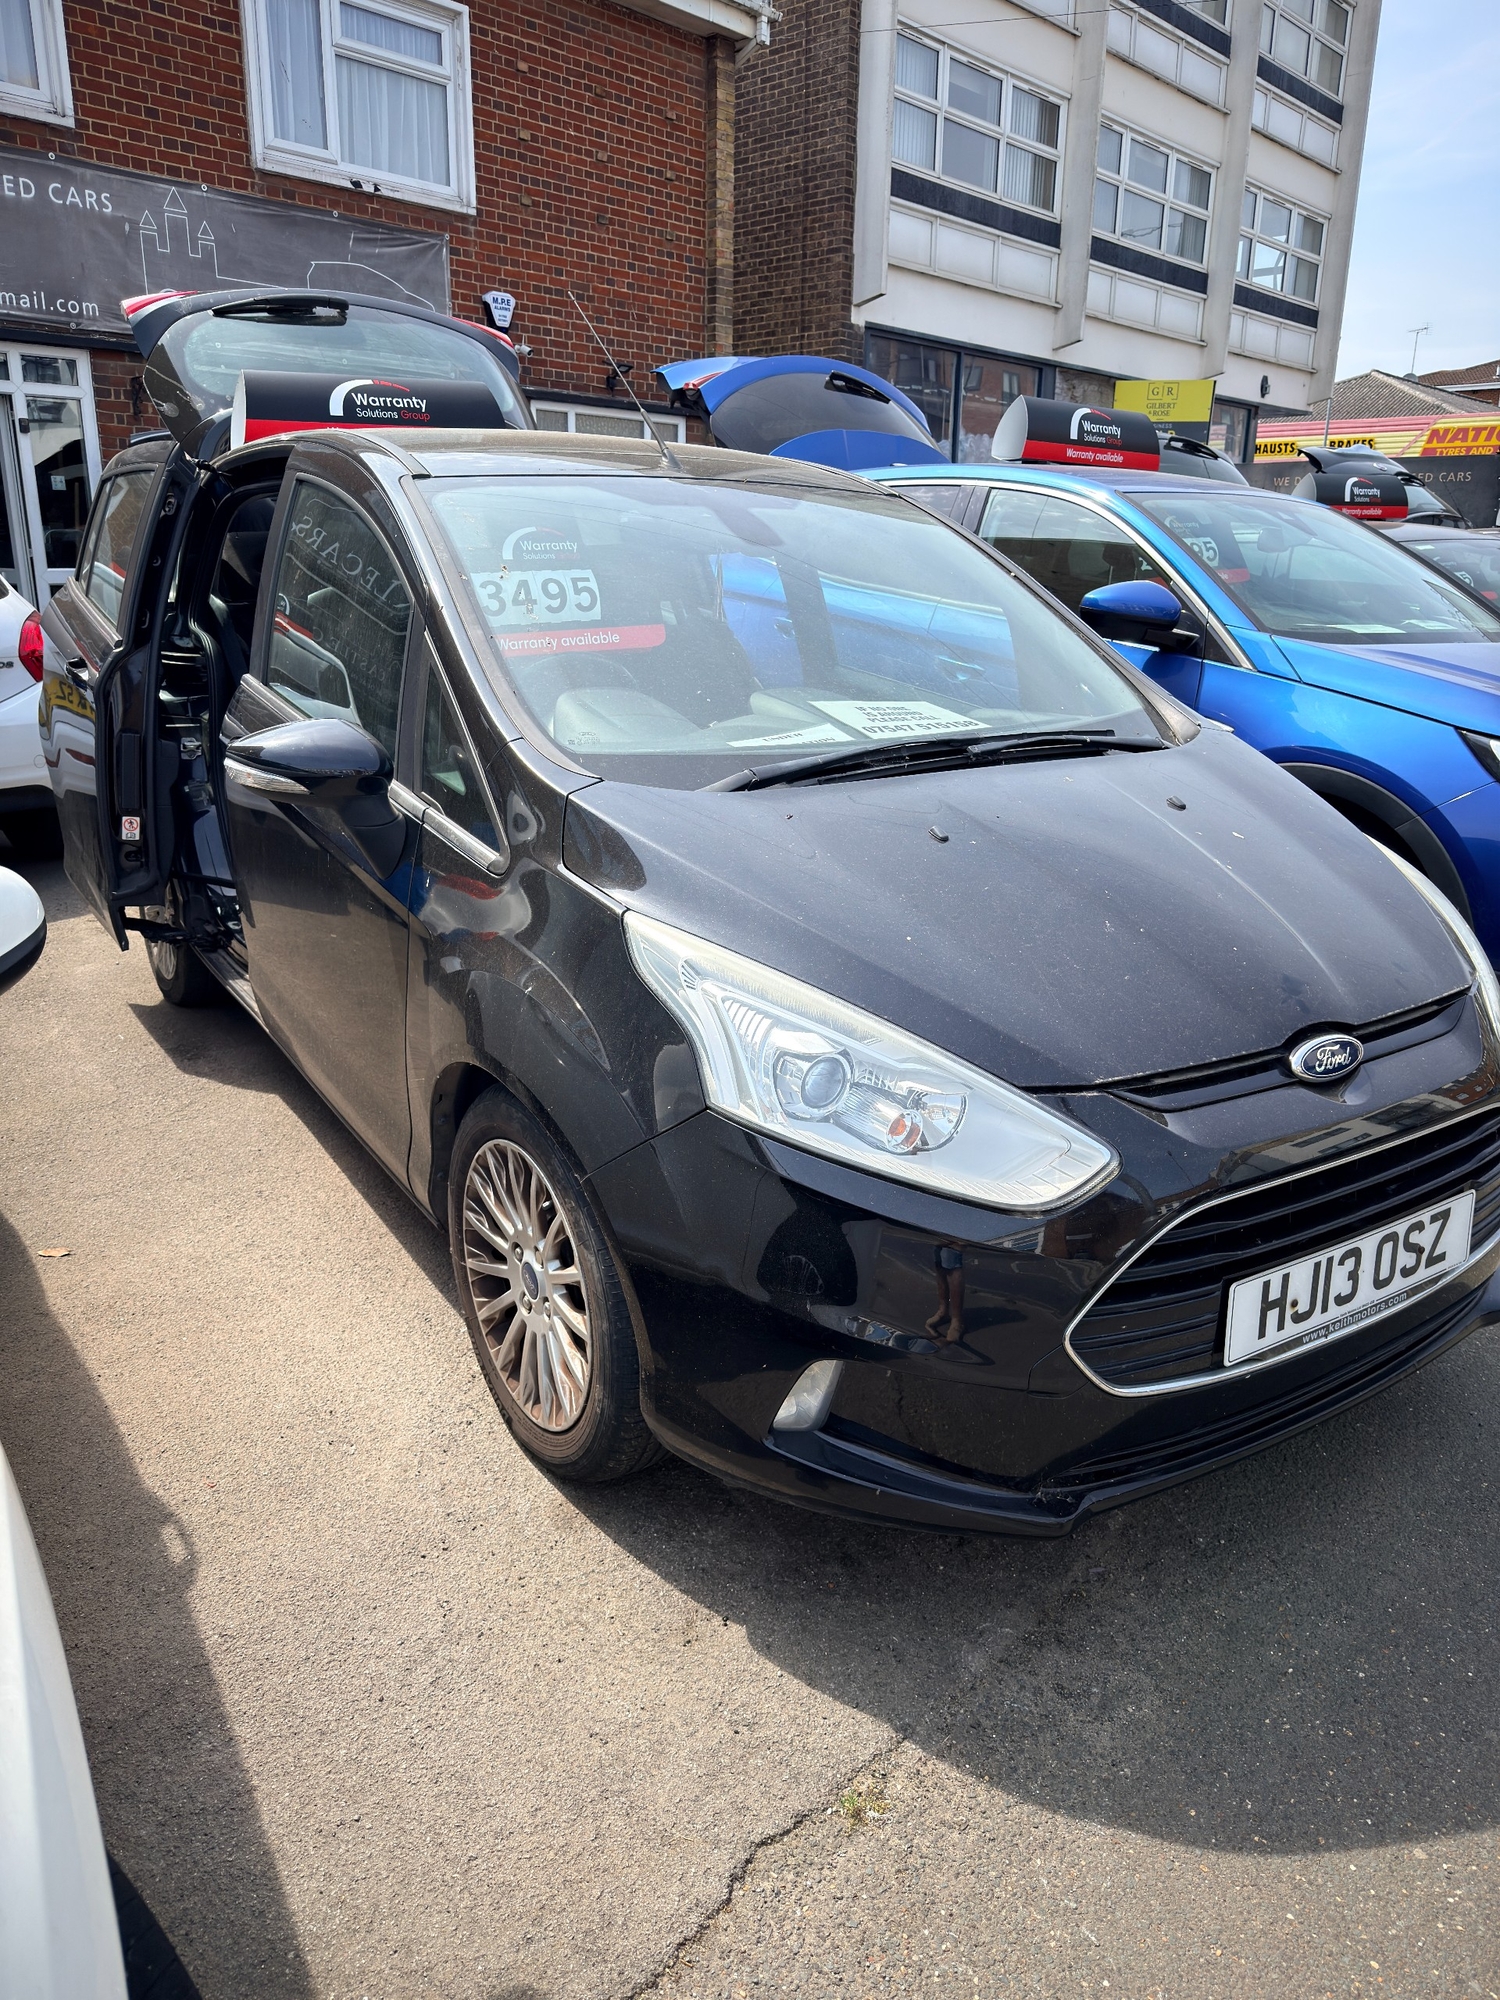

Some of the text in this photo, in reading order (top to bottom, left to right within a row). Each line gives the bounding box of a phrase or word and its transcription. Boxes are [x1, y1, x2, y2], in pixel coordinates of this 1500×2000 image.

[48, 183, 114, 213] CARS
[1151, 387, 1174, 396] G R
[351, 392, 427, 412] Warranty
[1146, 402, 1177, 410] GILBERT
[356, 407, 431, 422] Solutions Group
[1152, 409, 1171, 417] ROSE
[1081, 420, 1121, 438] Warranty
[1425, 425, 1500, 445] NATI
[1083, 433, 1123, 447] Solutions Group
[1066, 447, 1124, 463] Warranty available
[1435, 446, 1494, 456] TYRES AND
[1273, 476, 1291, 486] WE
[1438, 471, 1472, 482] CARS
[1352, 486, 1381, 498] Warranty
[519, 540, 578, 553] Warranty
[522, 552, 556, 560] Solutions
[478, 576, 599, 617] 3495
[499, 631, 620, 651] Warranty available
[861, 724, 916, 734] 07547
[1315, 1043, 1352, 1073] Ford
[1257, 1206, 1452, 1341] HJ13 OSZ
[1301, 1291, 1408, 1345] www.keithmotors.com
